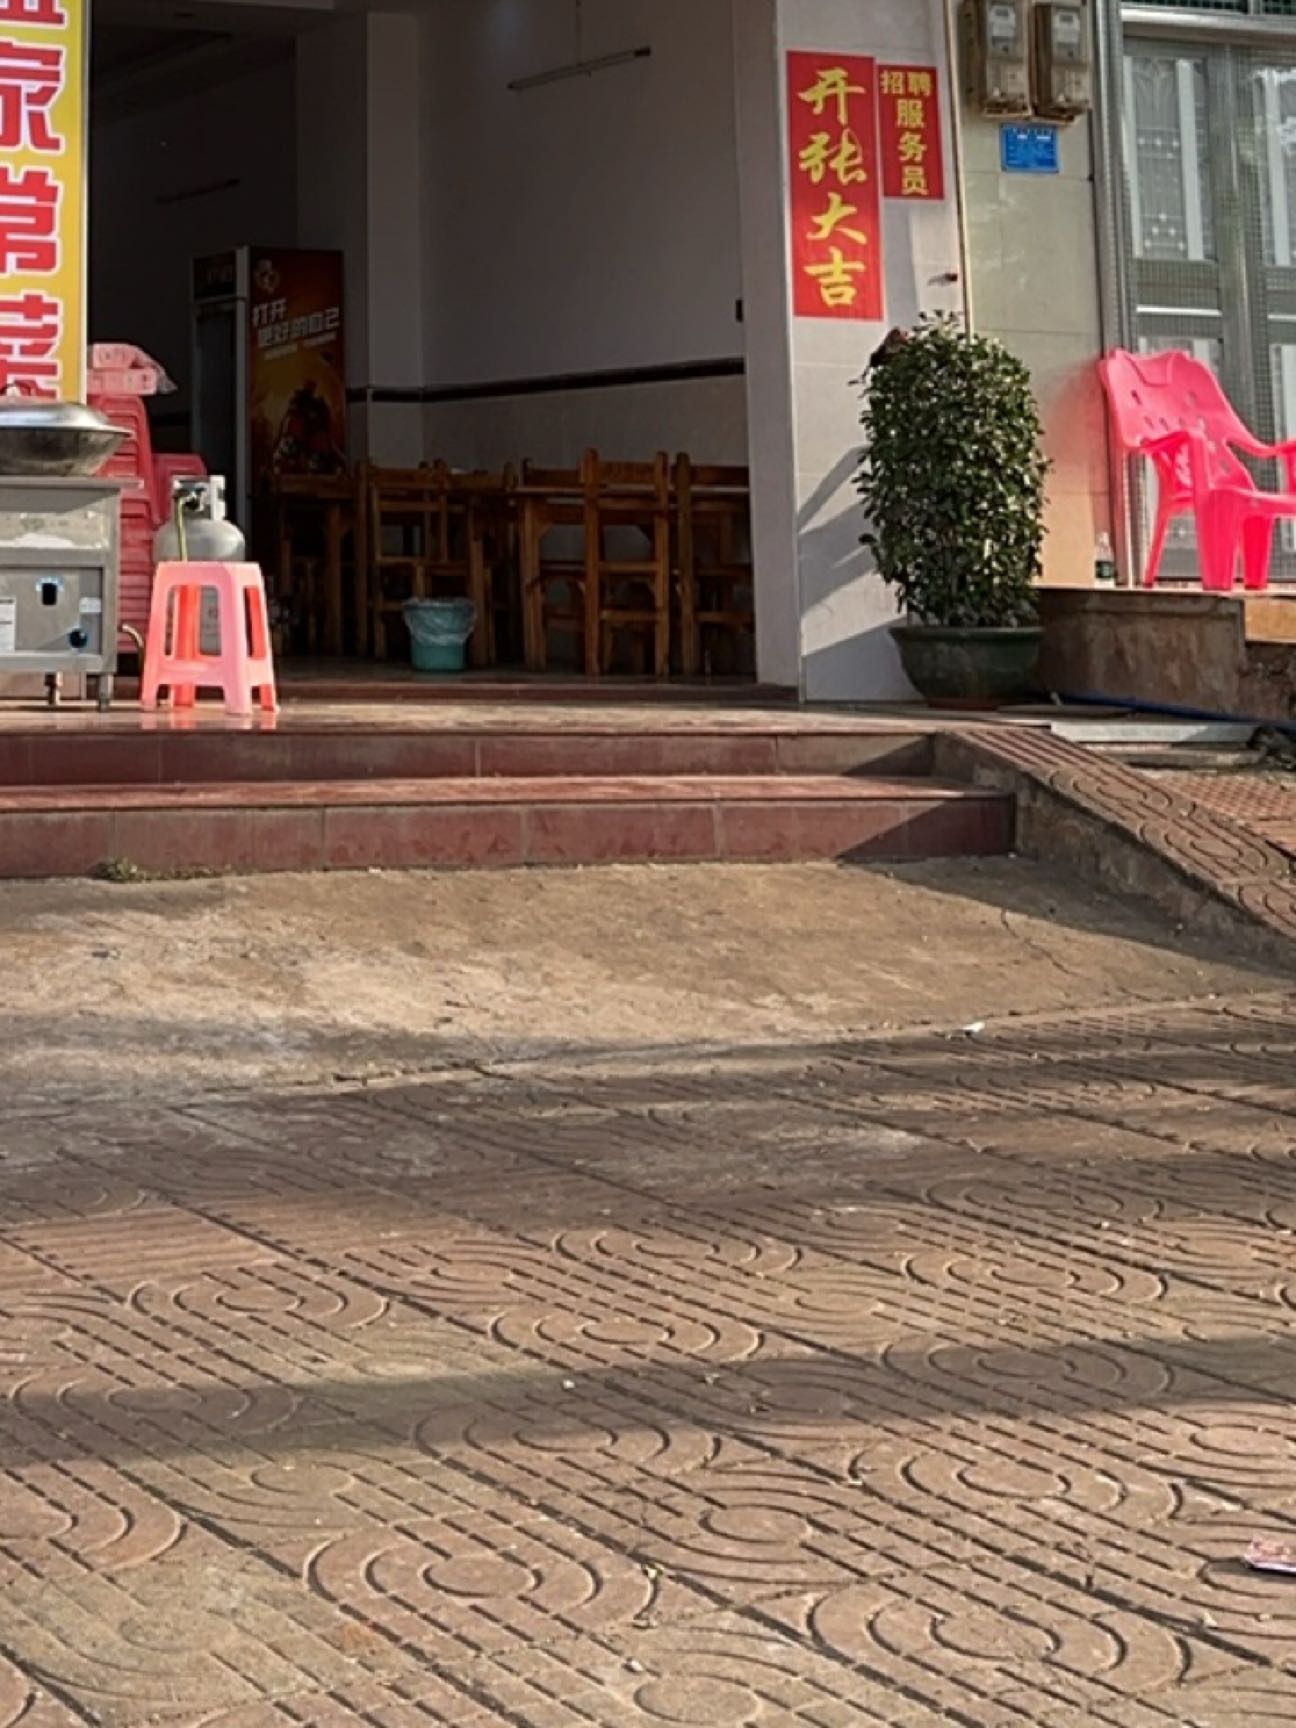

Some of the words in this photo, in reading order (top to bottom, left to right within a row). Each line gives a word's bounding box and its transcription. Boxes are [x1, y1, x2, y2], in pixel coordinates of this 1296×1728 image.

[879, 70, 933, 97] 招聘
[798, 66, 868, 308] 开张大吉
[895, 98, 930, 196] 服务员
